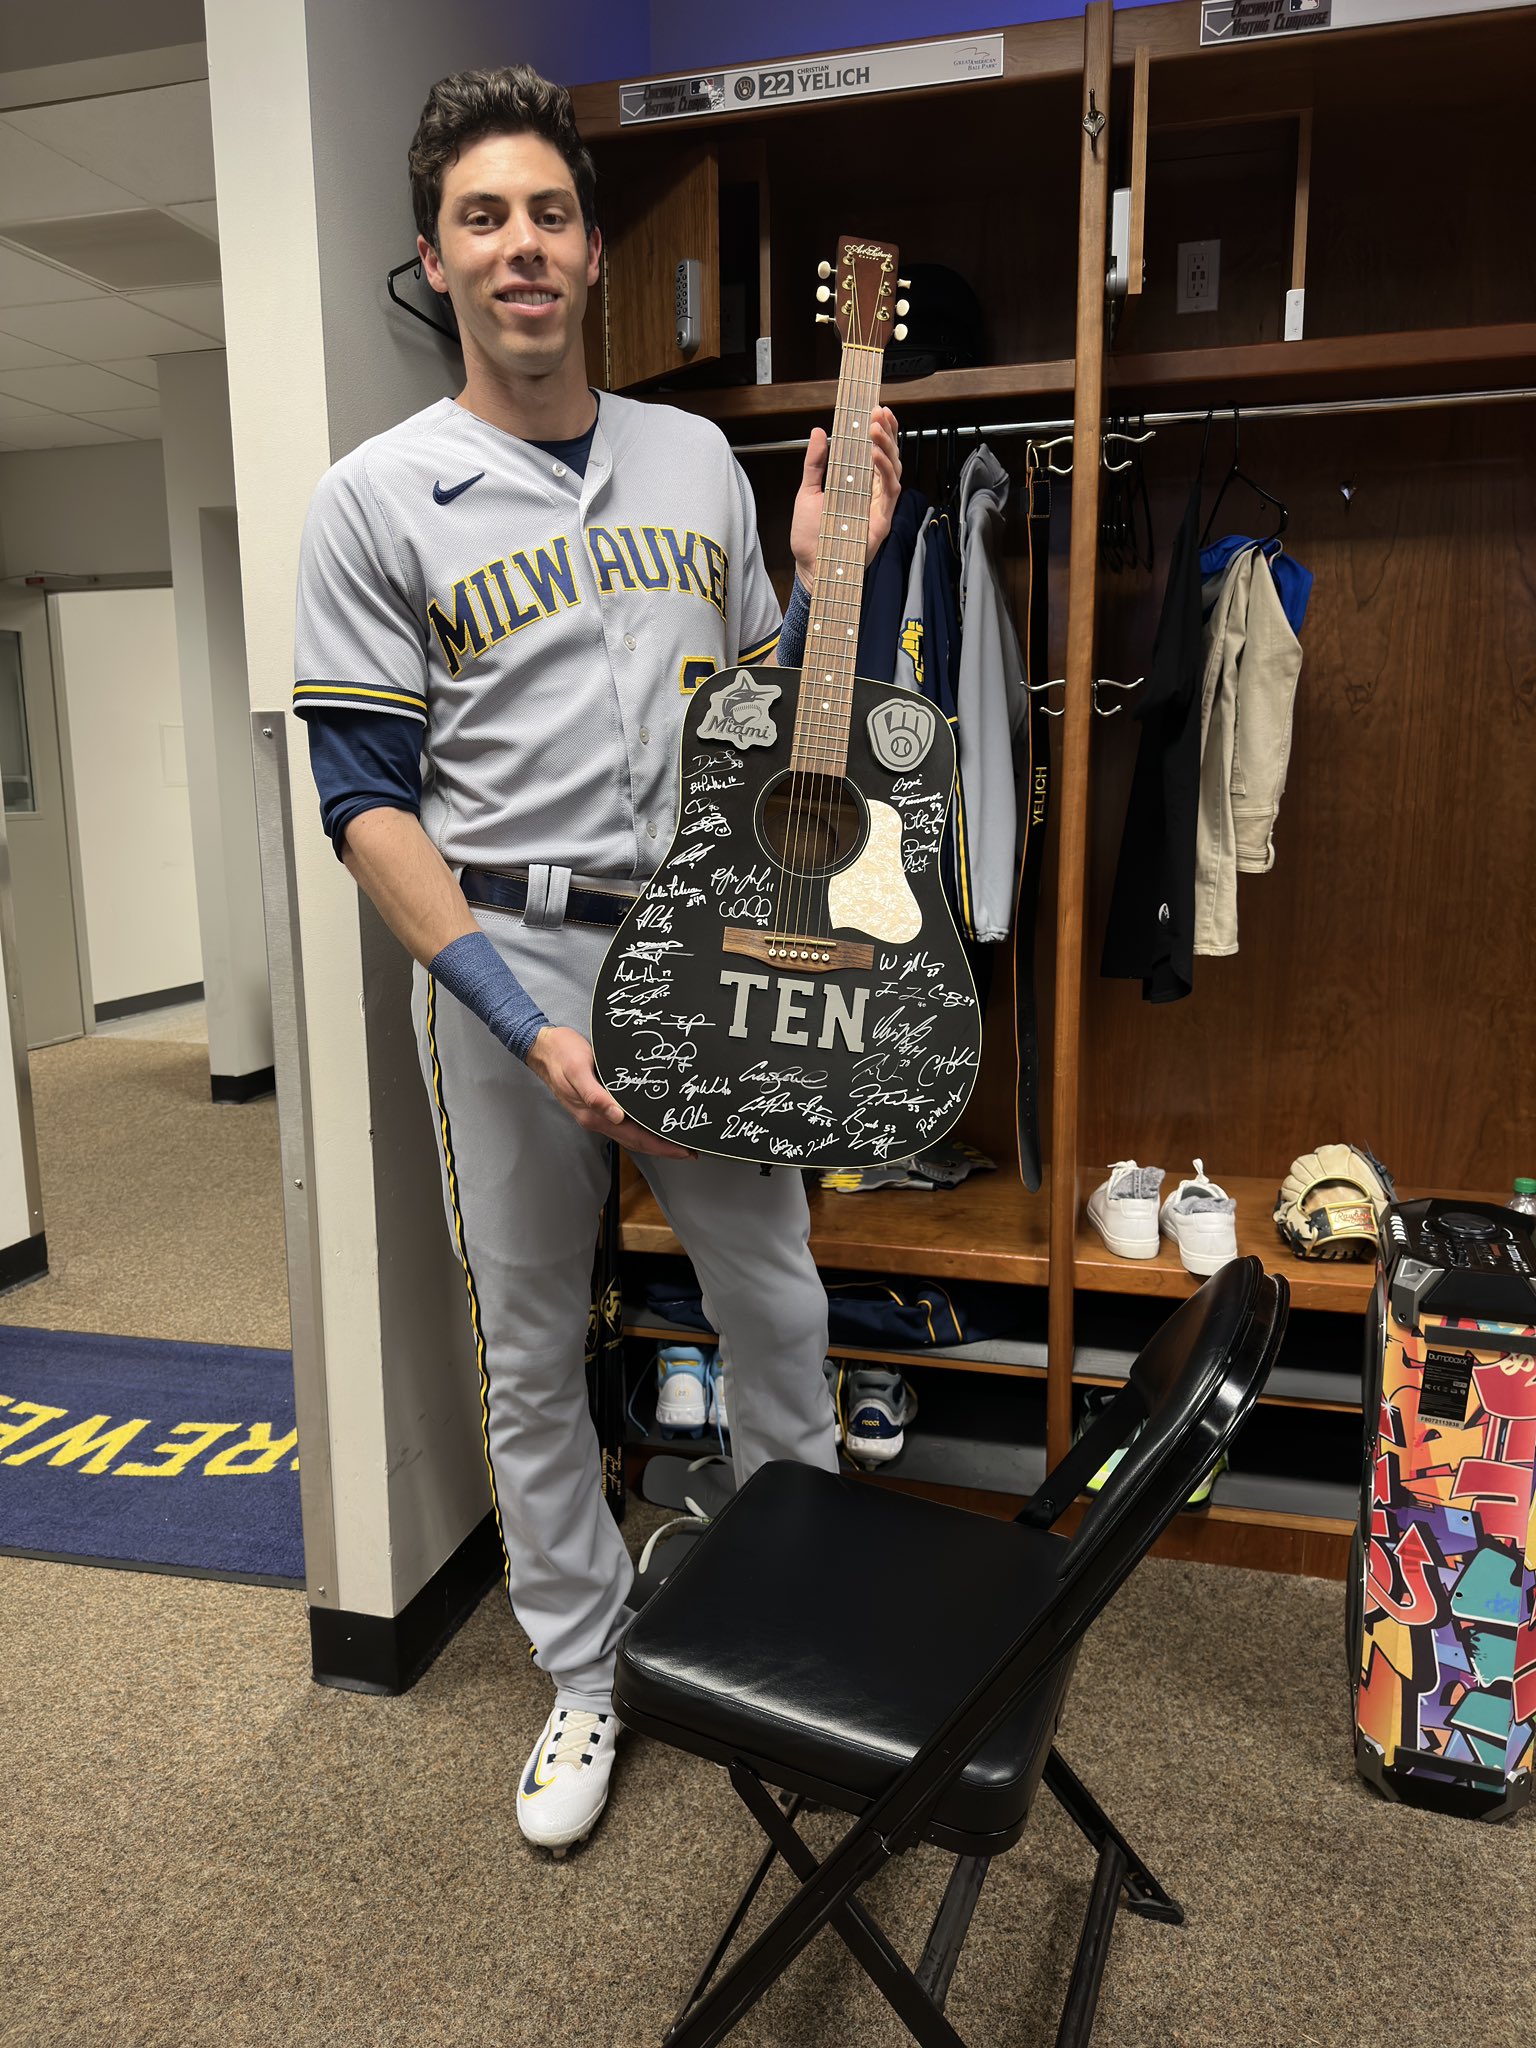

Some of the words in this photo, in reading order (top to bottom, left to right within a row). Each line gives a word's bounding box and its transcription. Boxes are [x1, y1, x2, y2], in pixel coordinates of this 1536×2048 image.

[1273, 12, 1329, 31] CLUBHOUSE
[797, 65, 830, 75] CHRISTIAN
[798, 66, 870, 92] YELICH
[763, 73, 790, 96] 22
[704, 714, 770, 739] Miami
[1032, 766, 1048, 826] YELICH
[720, 970, 870, 1053] TEN
